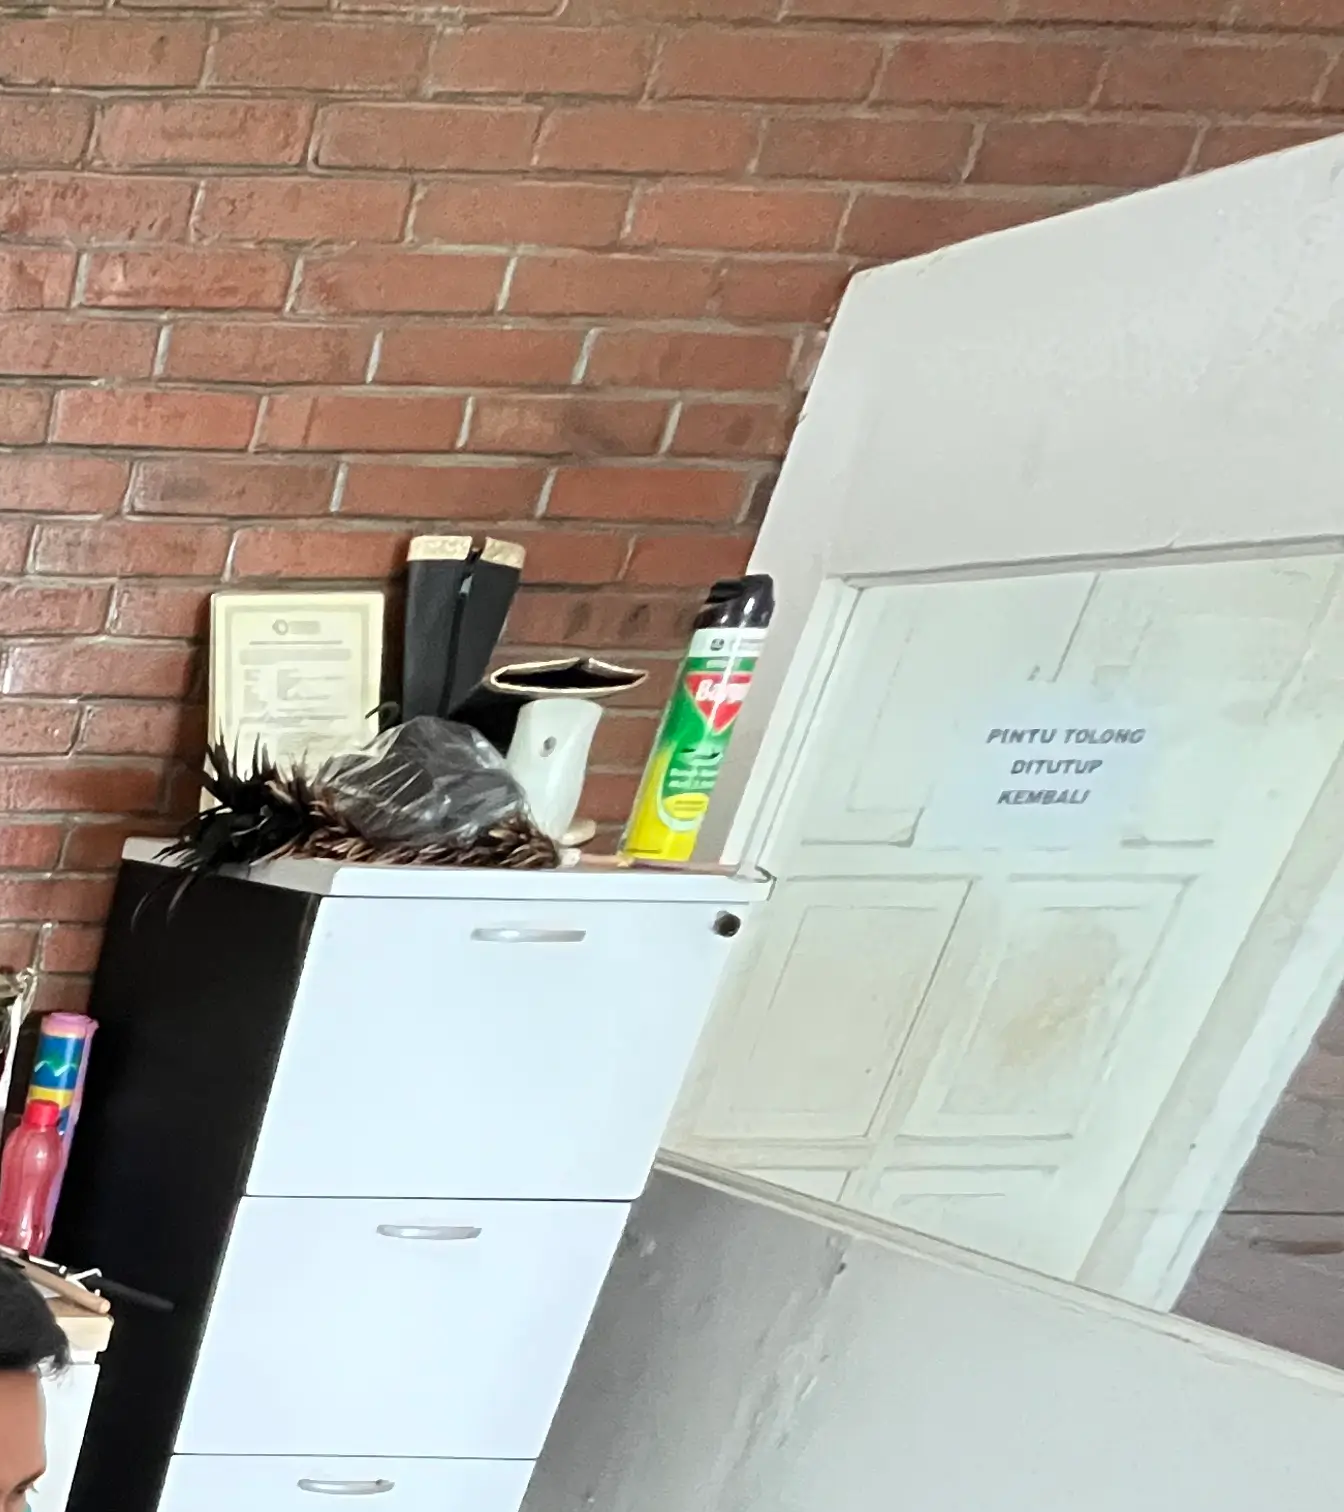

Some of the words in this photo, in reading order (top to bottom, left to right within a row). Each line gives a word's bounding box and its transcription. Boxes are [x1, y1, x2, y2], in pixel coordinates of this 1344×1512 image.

[986, 728, 1058, 744] PINTU
[1064, 728, 1146, 744] TOLONG
[1010, 759, 1104, 775] DITUTUP
[997, 788, 1091, 805] KEMBALI
